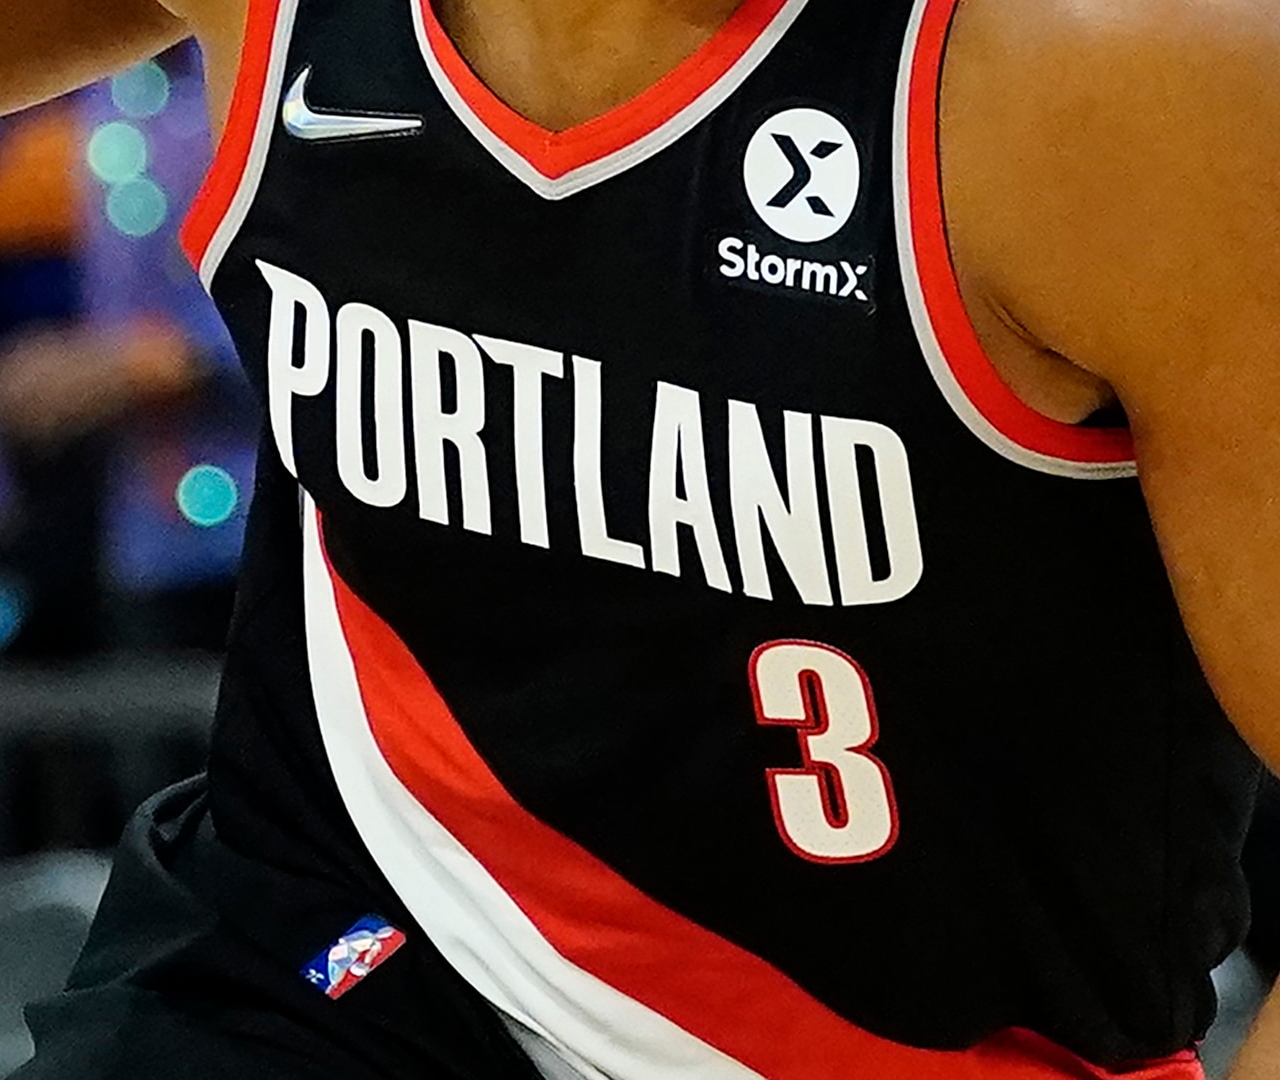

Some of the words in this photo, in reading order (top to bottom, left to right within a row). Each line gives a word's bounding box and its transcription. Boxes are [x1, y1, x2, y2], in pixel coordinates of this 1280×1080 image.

[717, 236, 868, 301] StormX
[254, 258, 925, 608] PORTLAND
[748, 638, 898, 865] 3
